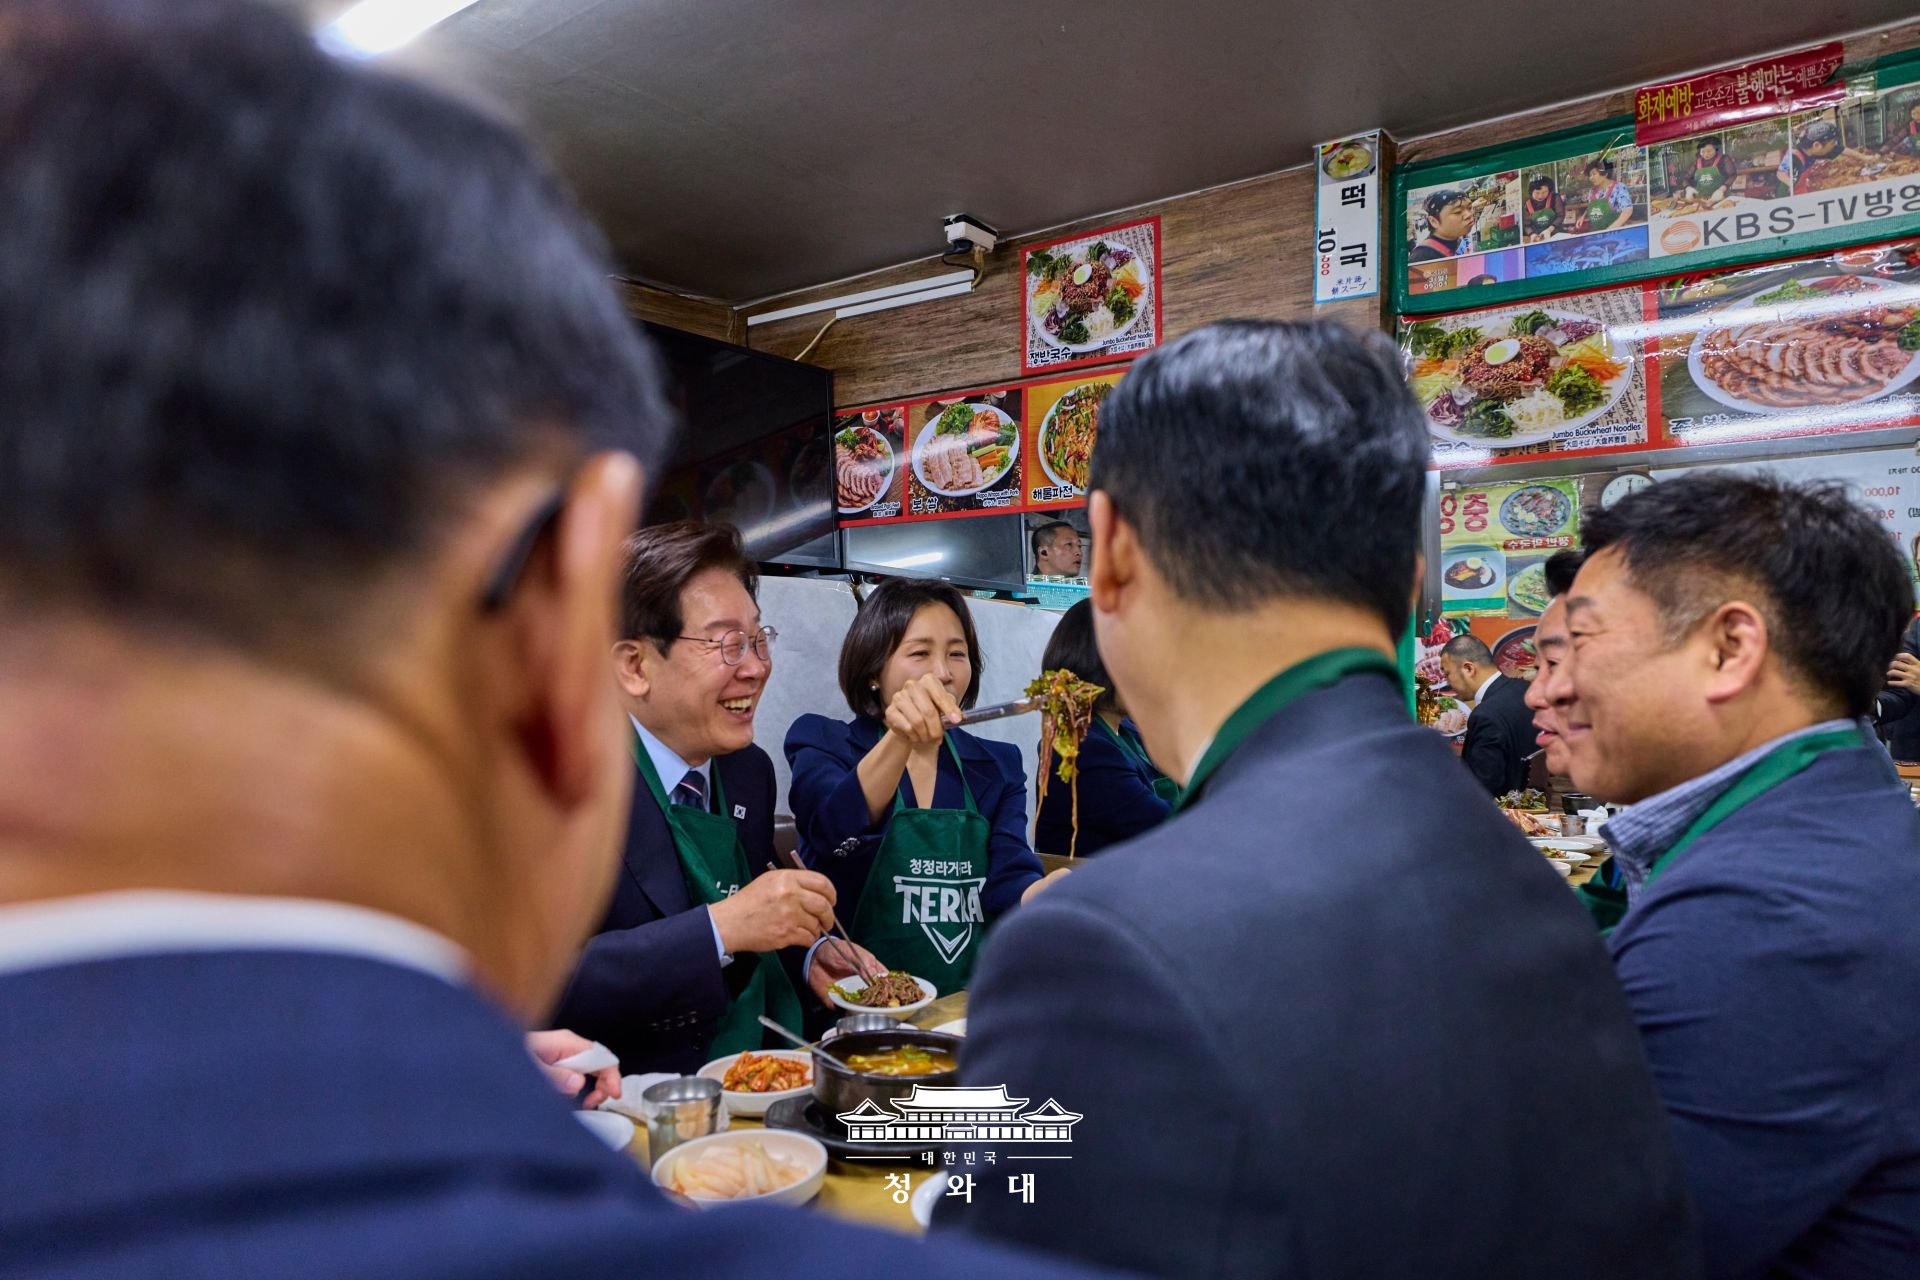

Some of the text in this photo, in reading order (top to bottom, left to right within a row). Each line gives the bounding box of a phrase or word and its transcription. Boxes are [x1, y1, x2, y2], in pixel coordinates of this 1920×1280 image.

[1638, 83, 1694, 124] 화재예방
[1735, 64, 1796, 105] 불행막는
[1029, 346, 1072, 364] 쟁반국수
[1551, 423, 1641, 440] Jumbo Buckwheat Noodles
[1032, 485, 1073, 501] 해물파전
